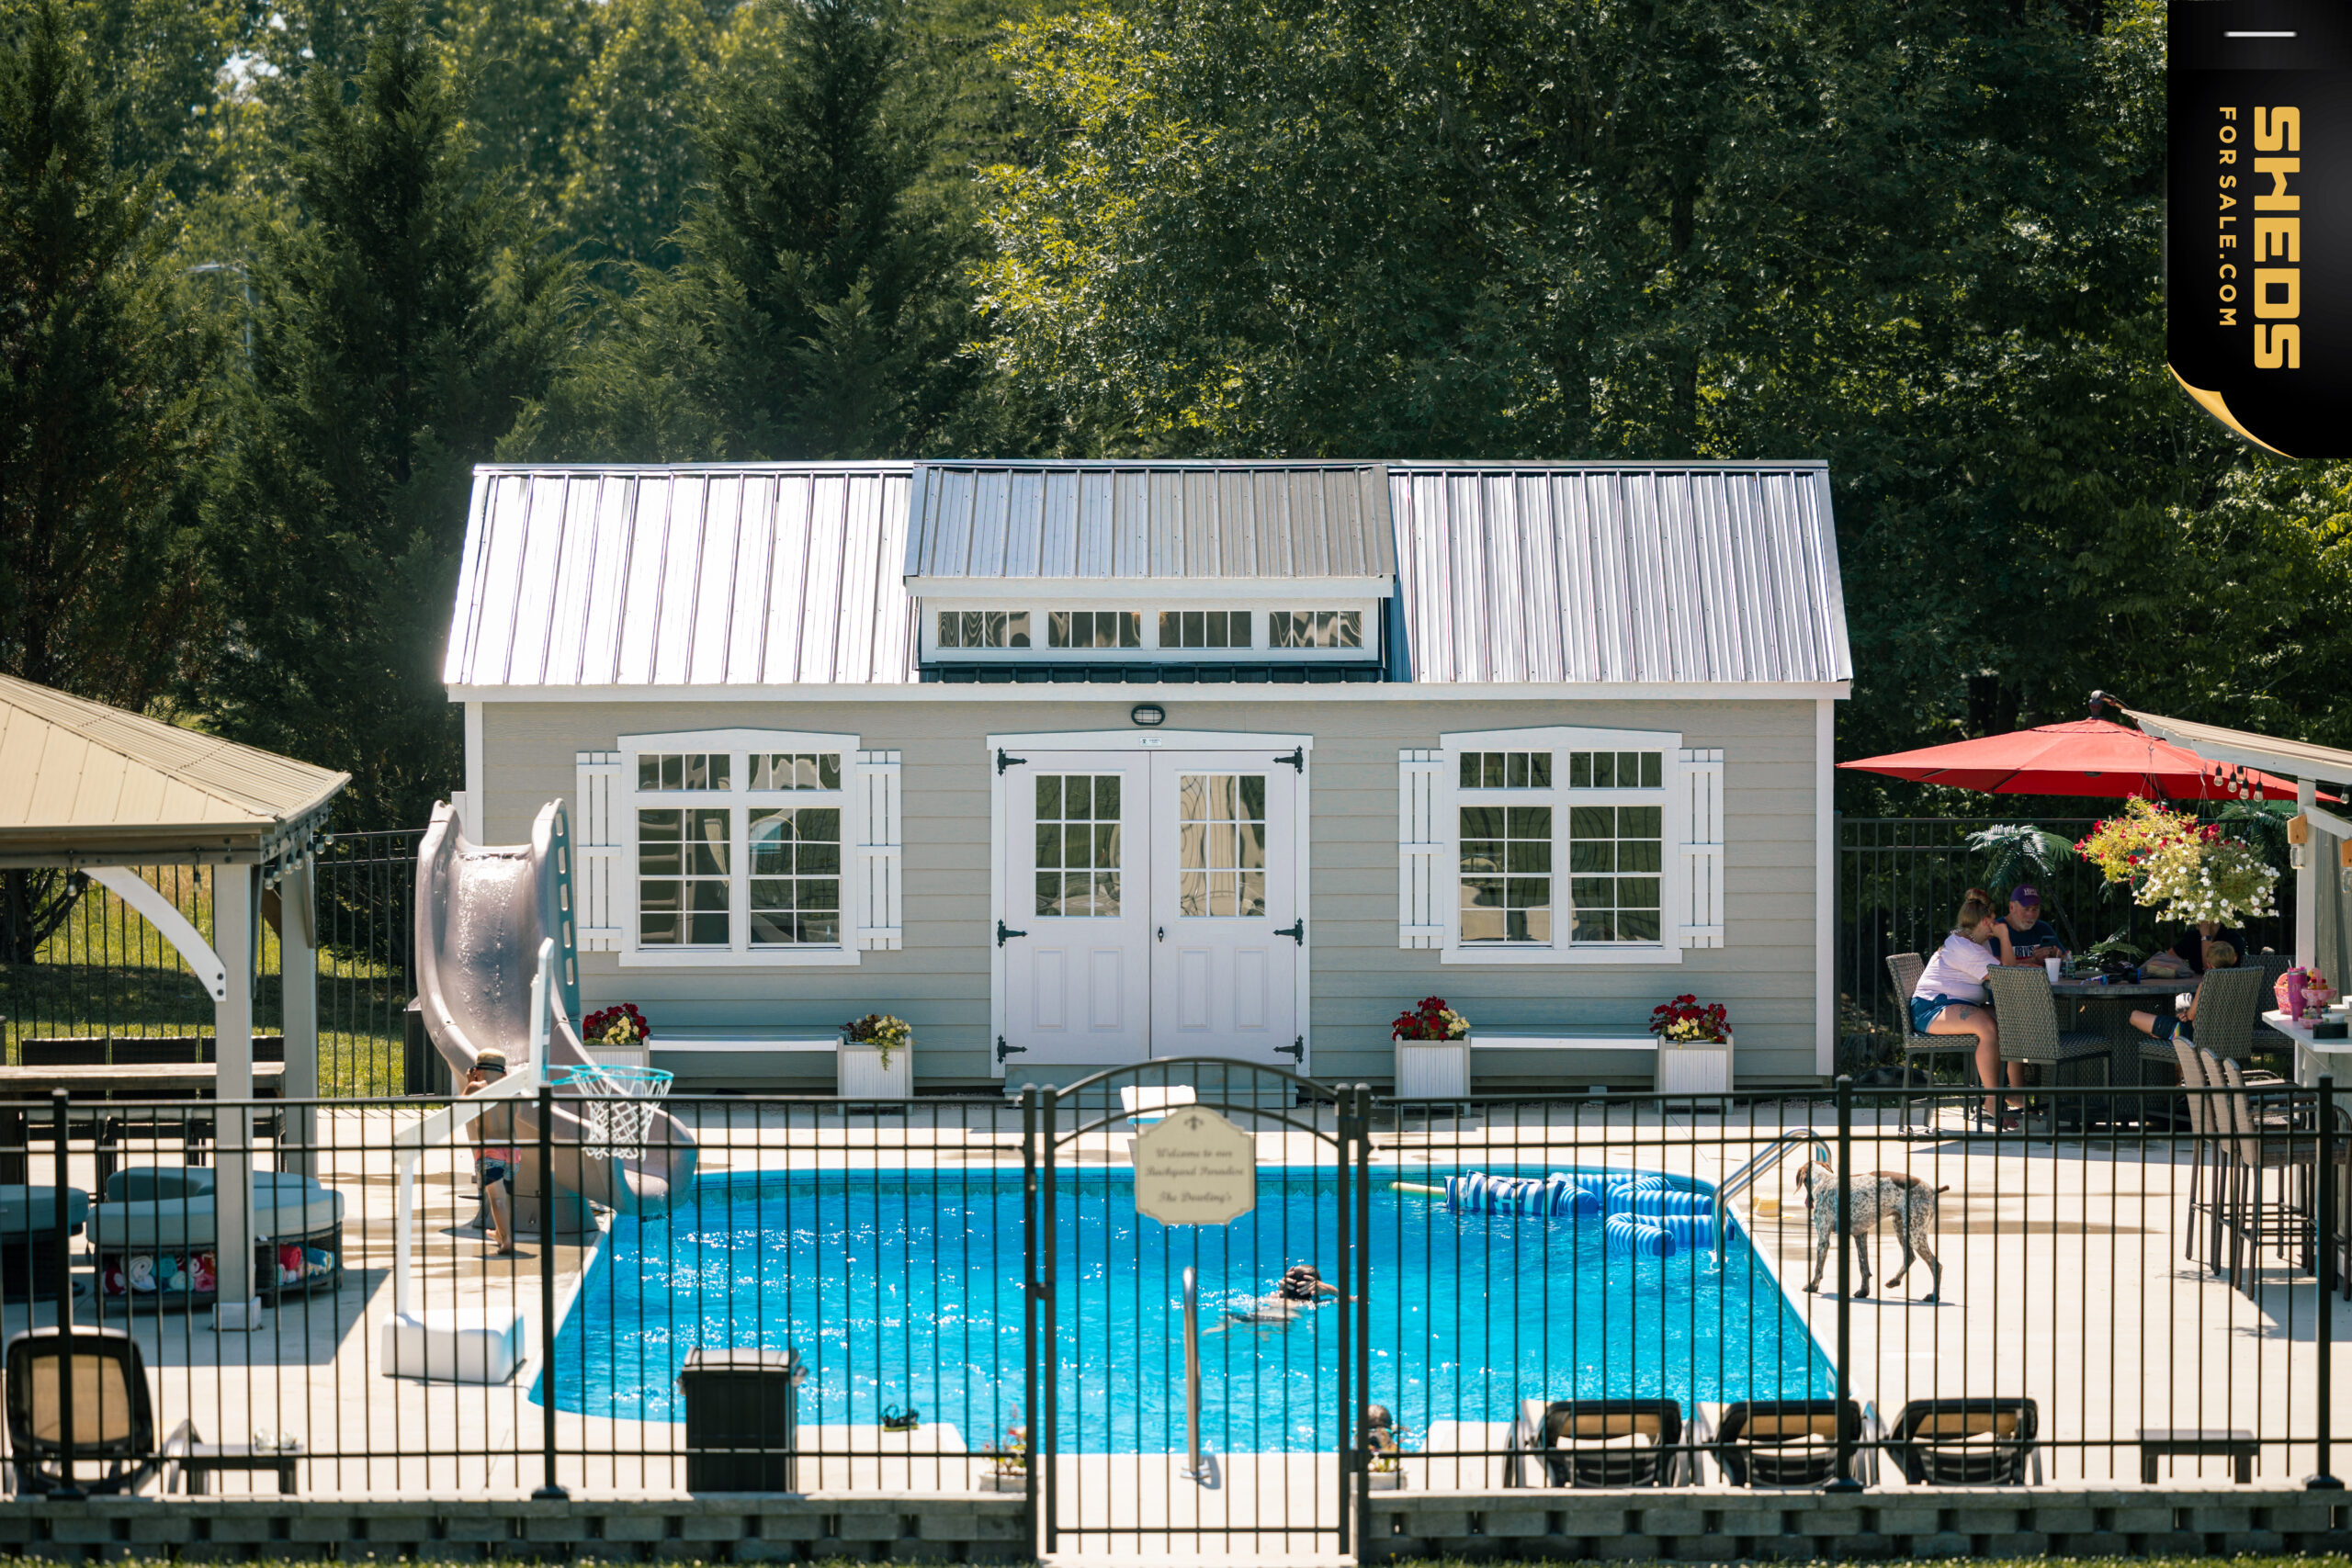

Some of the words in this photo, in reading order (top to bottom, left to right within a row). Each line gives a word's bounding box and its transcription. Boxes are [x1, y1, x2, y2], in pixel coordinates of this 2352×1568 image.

[1156, 1147, 1200, 1157] Welcome
[1203, 1148, 1212, 1157] to
[1146, 1166, 1196, 1179] Backyard
[1200, 1166, 1244, 1176] Paradise
[1158, 1190, 1178, 1203] The
